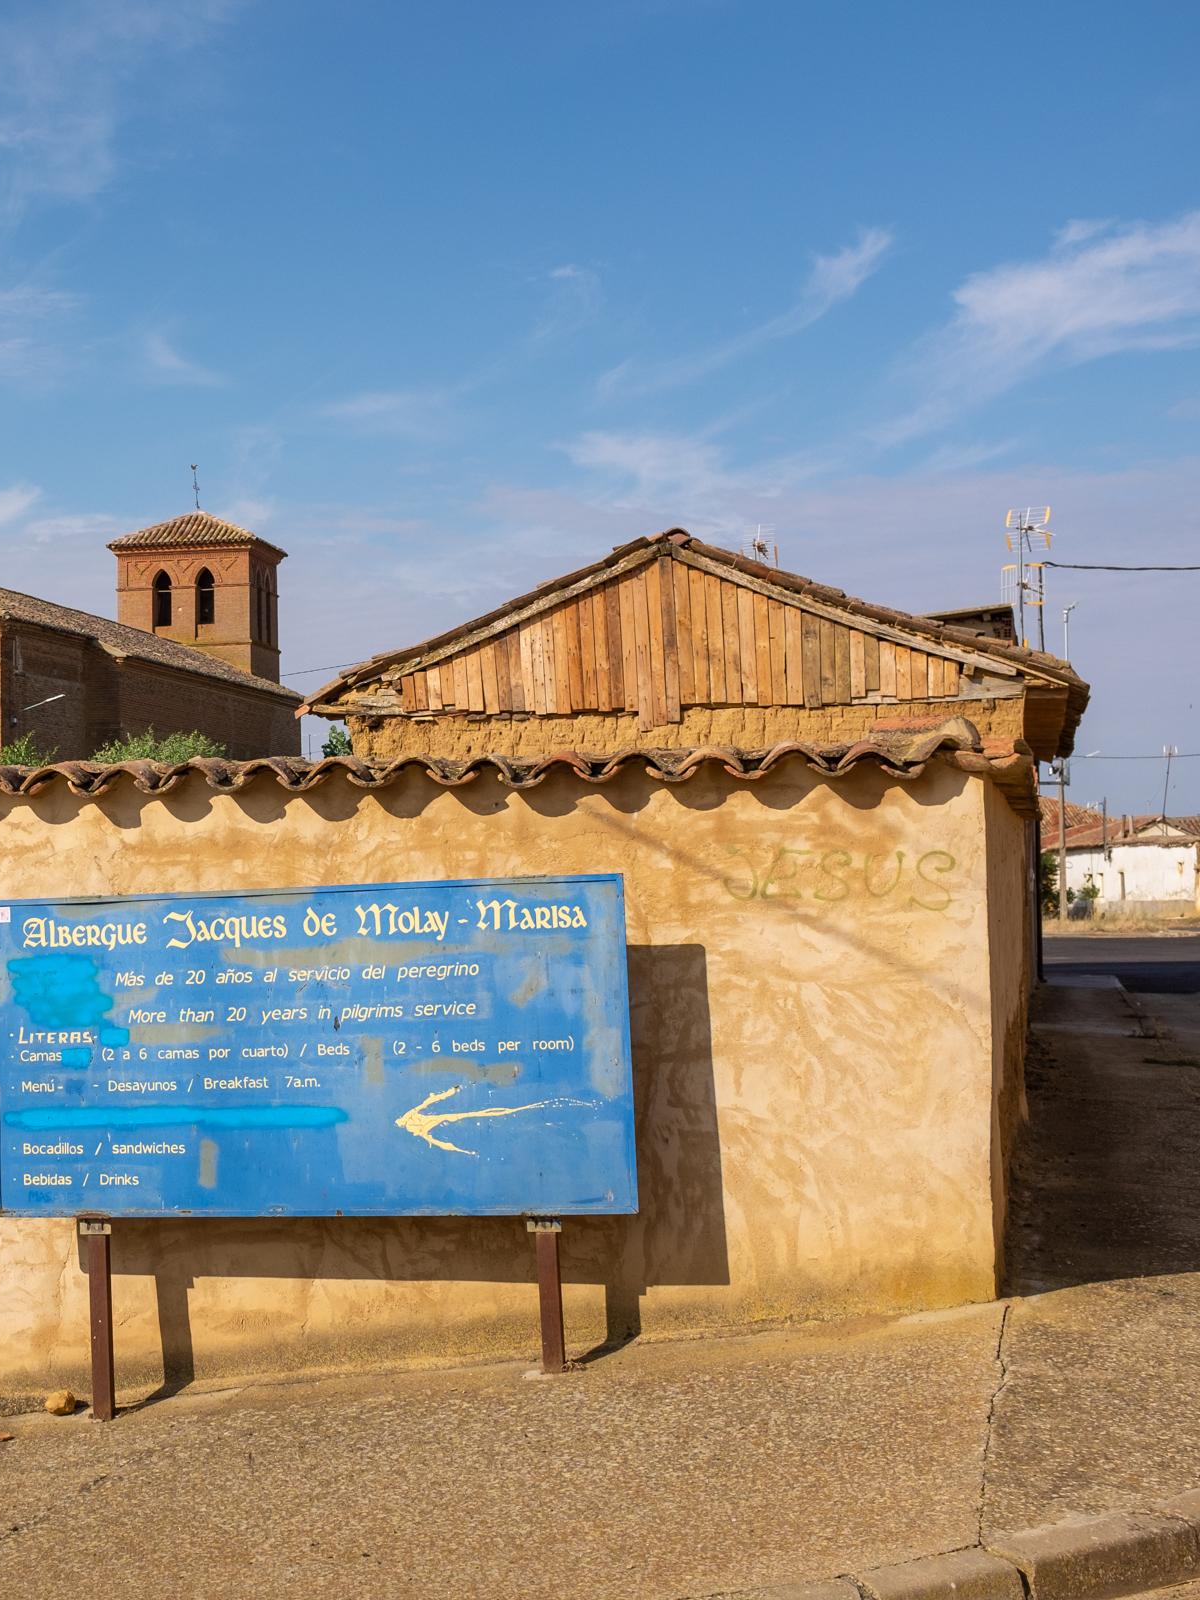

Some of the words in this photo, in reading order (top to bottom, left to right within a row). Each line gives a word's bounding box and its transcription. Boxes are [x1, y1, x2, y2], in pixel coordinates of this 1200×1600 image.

[114, 970, 145, 987] Más
[154, 969, 174, 986] de
[184, 968, 206, 986] 20
[214, 966, 254, 985] años
[262, 967, 278, 983] al
[286, 964, 352, 984] servicio
[360, 963, 387, 980] del
[396, 960, 481, 983] peregrino
[127, 1008, 167, 1025] More
[178, 1007, 215, 1024] than
[225, 1006, 248, 1022] 20
[260, 1006, 309, 1026] years
[317, 1003, 332, 1020] in
[340, 1002, 404, 1024] pilgrims
[413, 999, 478, 1018] service
[19, 1048, 63, 1063] Camas
[101, 1046, 116, 1063] (2
[122, 1049, 131, 1061] a
[138, 1047, 149, 1061] 6
[156, 1046, 200, 1061] camas
[208, 1047, 232, 1061] por
[241, 1042, 290, 1059] cuarto)
[316, 1041, 351, 1057] Beds
[392, 1039, 407, 1057] (2
[431, 1039, 442, 1054] 6
[451, 1037, 487, 1053] beds
[497, 1038, 522, 1055] per
[531, 1035, 575, 1053] room)
[107, 1078, 178, 1096] Desayunos
[202, 1075, 270, 1091] Breakfast
[283, 1074, 322, 1089] 7a.m.
[22, 1142, 84, 1155] Bocadillos
[111, 1141, 187, 1155] sandwiches
[23, 1173, 73, 1186] Bebidas
[99, 1173, 140, 1186] Drinks
